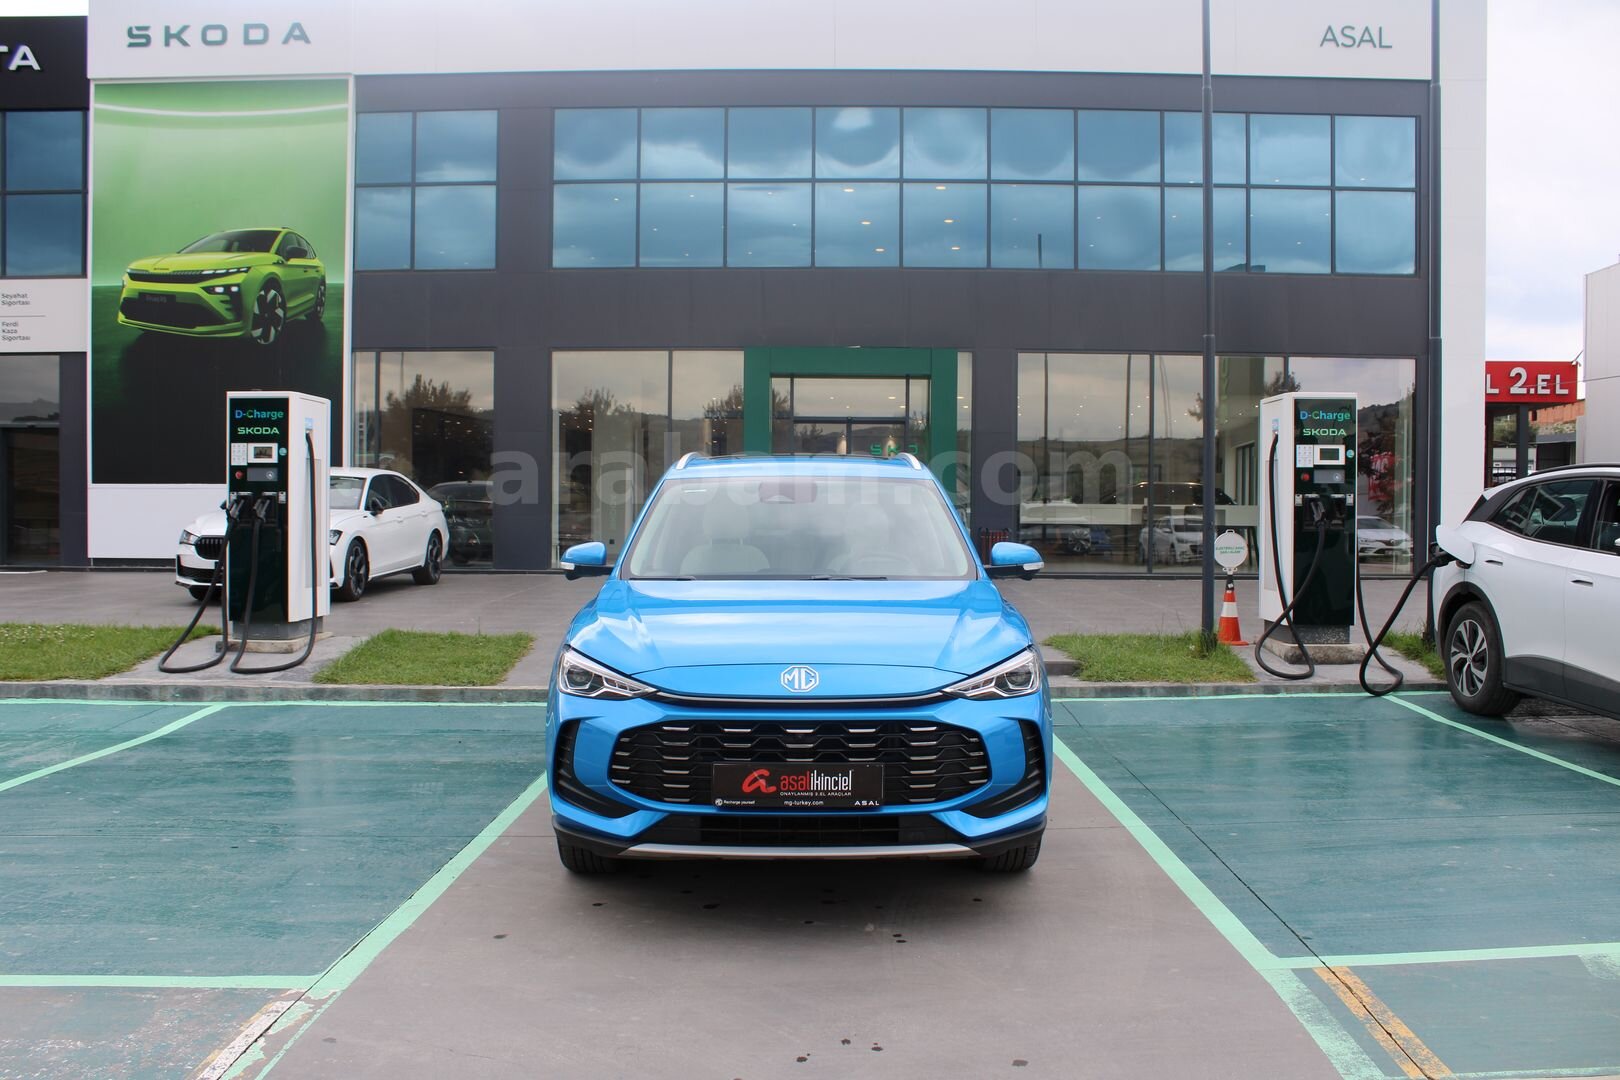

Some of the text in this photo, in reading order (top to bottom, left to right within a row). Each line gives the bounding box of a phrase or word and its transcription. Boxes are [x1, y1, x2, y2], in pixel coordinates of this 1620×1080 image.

[127, 22, 311, 48] SKODA
[1320, 25, 1393, 49] ASAL
[1509, 366, 1569, 395] 2.EL
[235, 409, 284, 420] D-Charge
[1300, 410, 1351, 421] D-Charge
[237, 427, 280, 435] SKODA
[1303, 428, 1347, 436] SKODA
[783, 667, 816, 690] MG
[779, 769, 852, 791] asalikinciel
